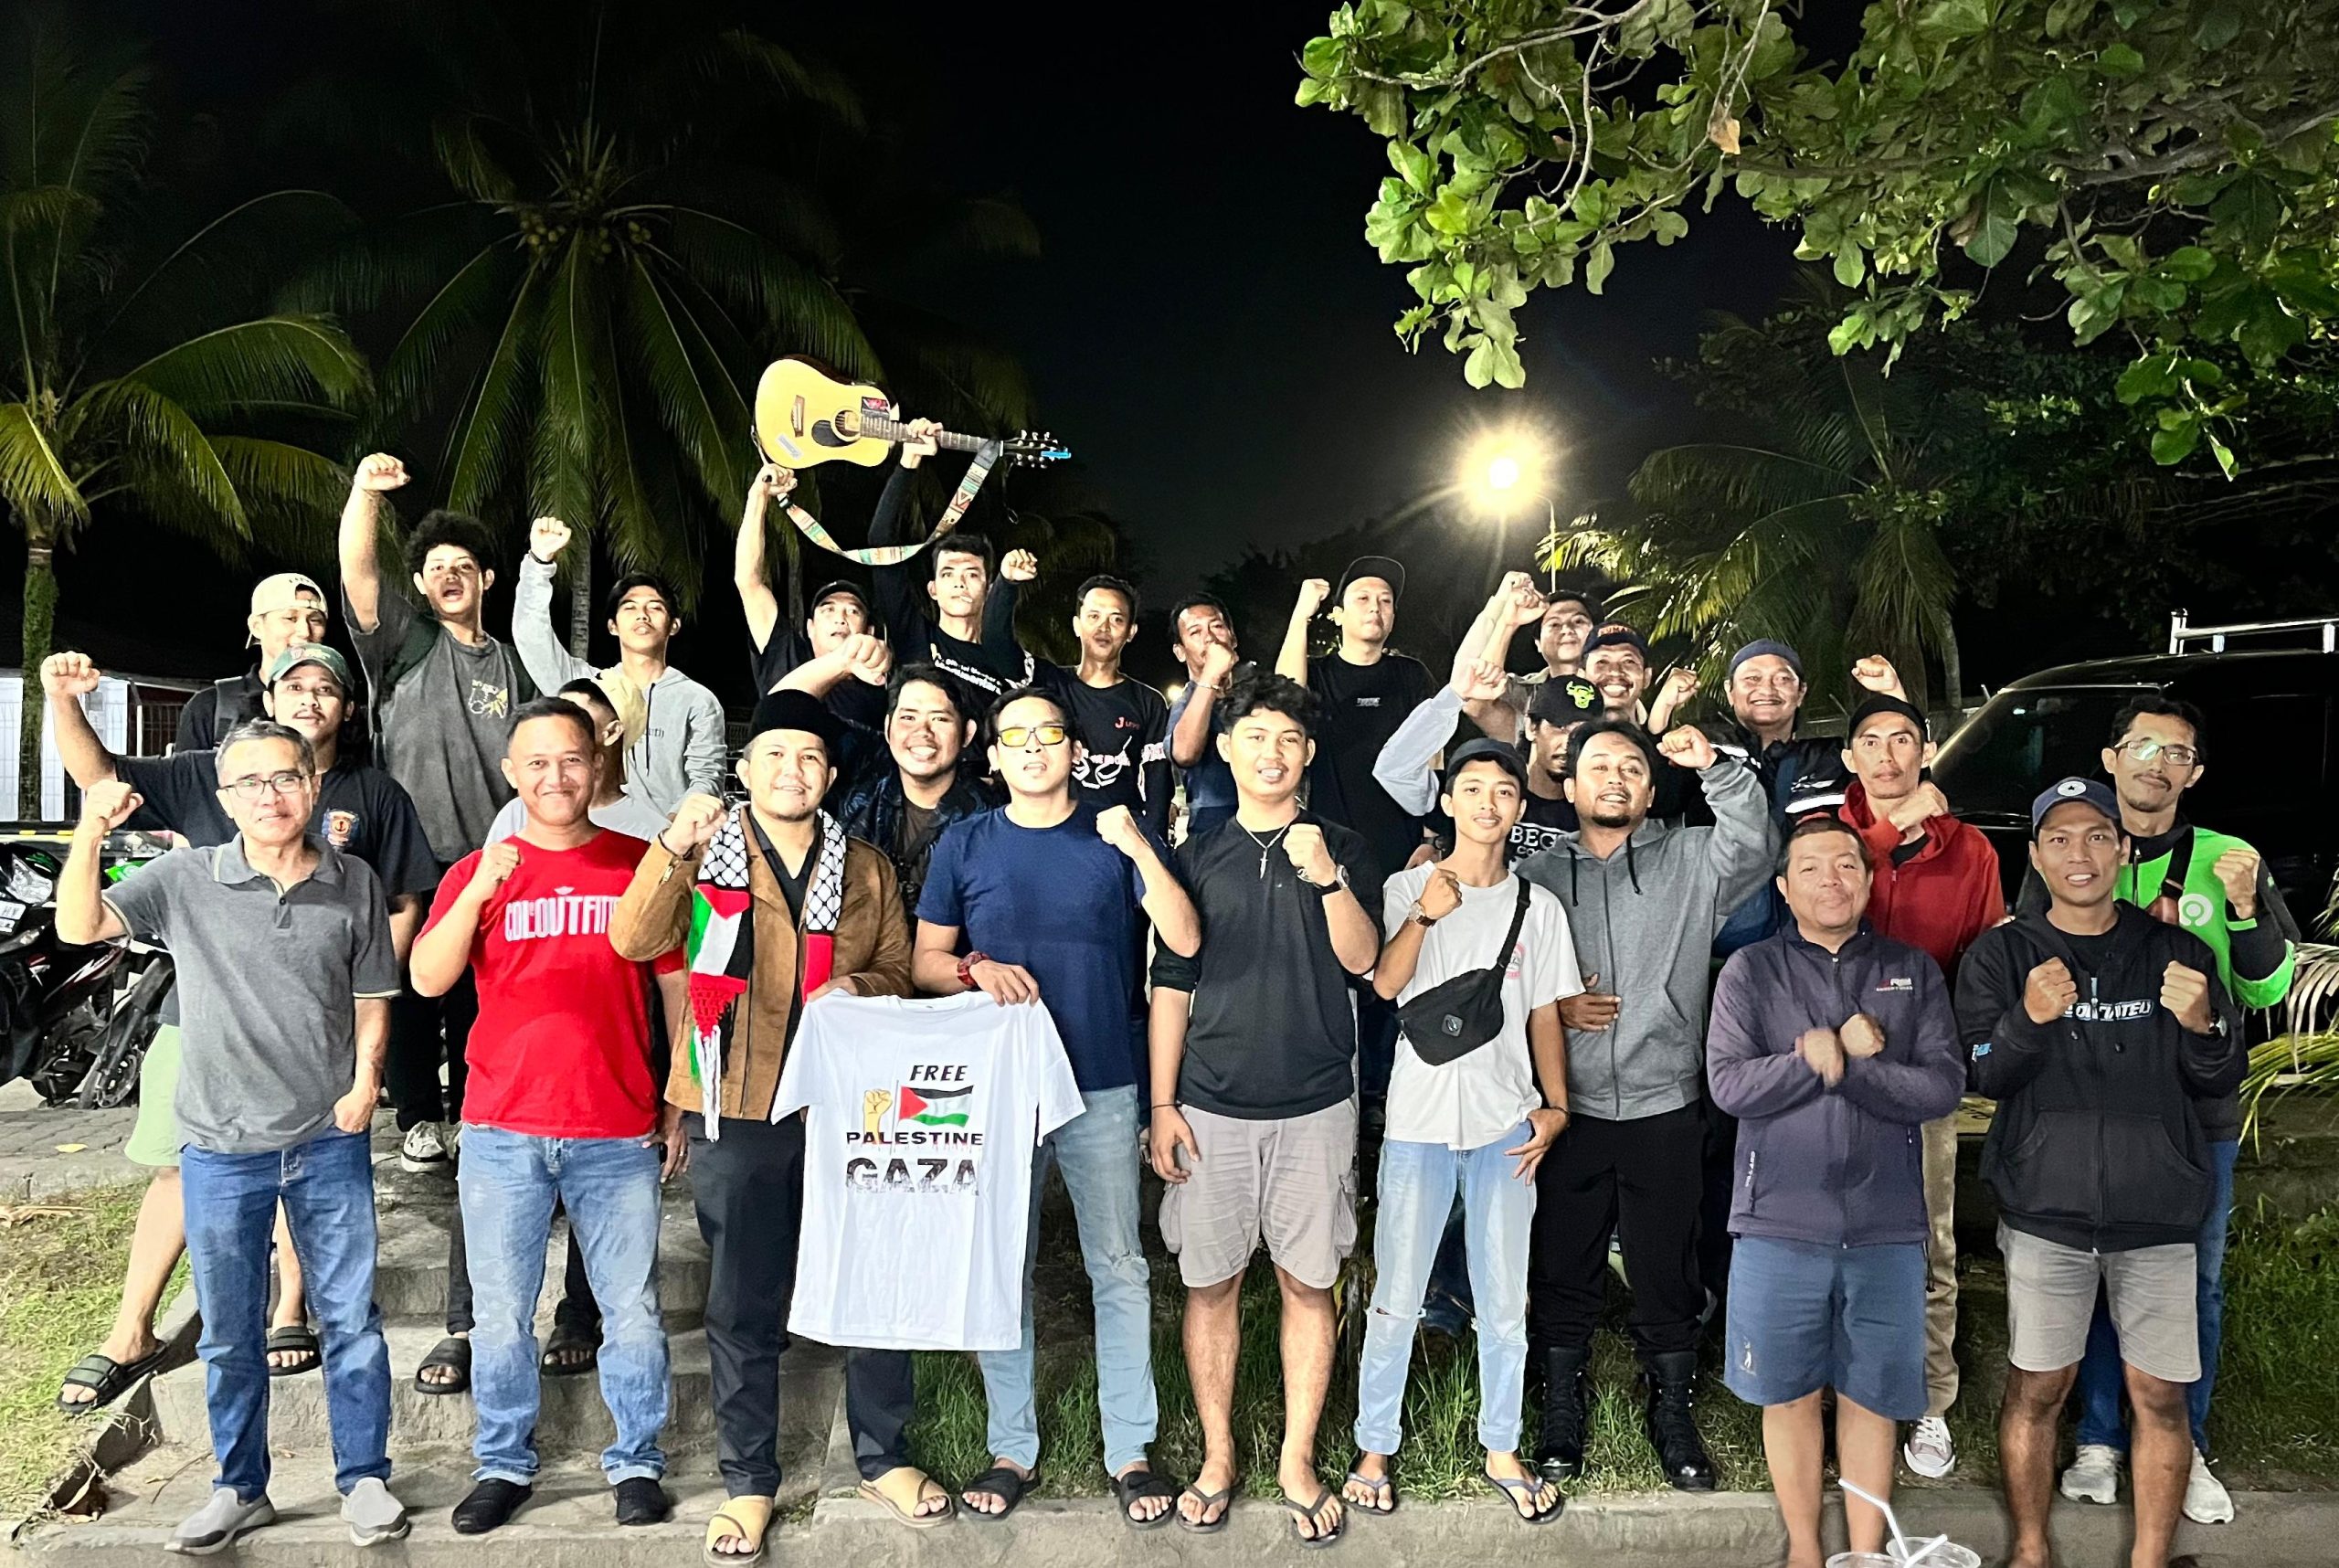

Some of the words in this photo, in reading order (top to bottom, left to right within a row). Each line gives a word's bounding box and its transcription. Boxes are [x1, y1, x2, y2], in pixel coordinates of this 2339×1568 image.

[909, 1065, 968, 1082] FREE
[846, 1131, 984, 1145] PALESTINE
[845, 1157, 979, 1193] GAZA
